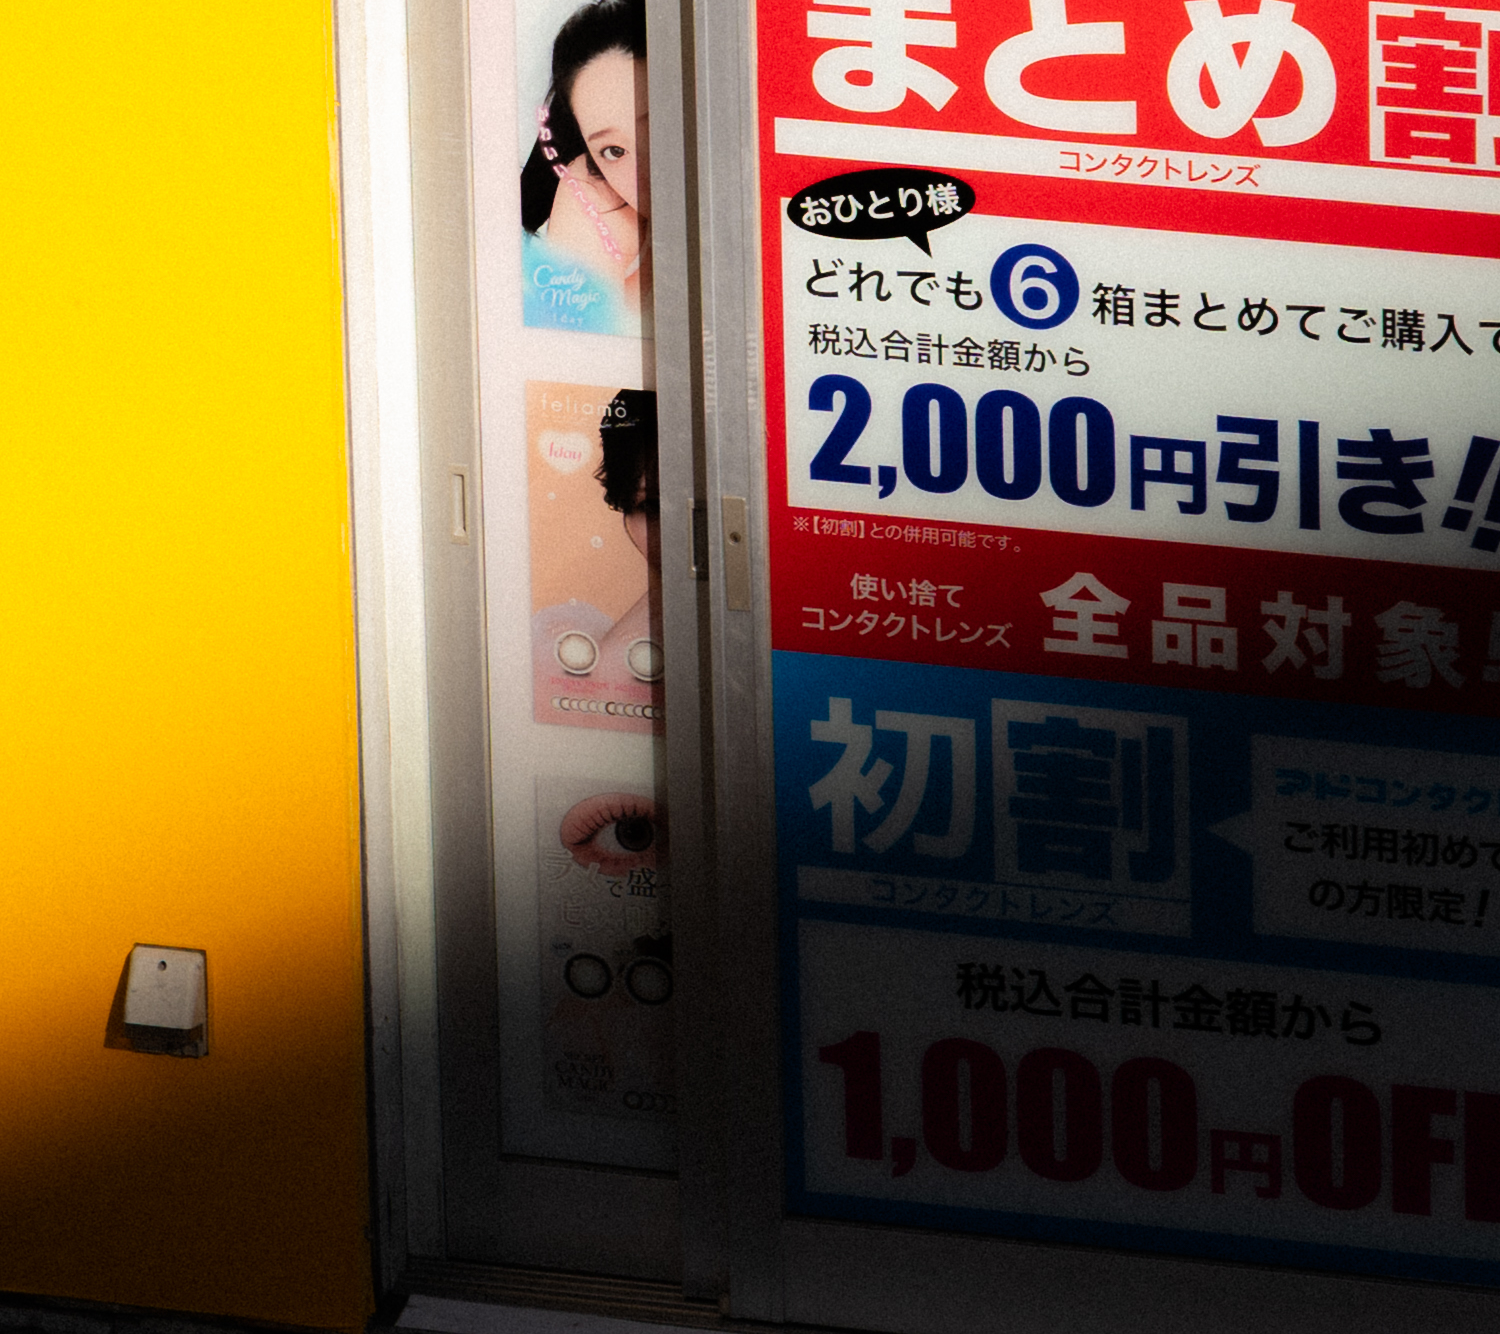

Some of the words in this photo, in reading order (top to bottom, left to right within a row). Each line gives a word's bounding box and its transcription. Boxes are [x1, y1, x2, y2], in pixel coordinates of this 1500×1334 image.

[1058, 151, 1261, 189] コンタクトレンズ
[799, 182, 965, 229] おひとり様
[808, 322, 1092, 378] 税込合計金額から
[850, 573, 965, 610] 使い捨て
[801, 606, 1011, 650] コンタクトレンズ
[809, 696, 1190, 885] 初割
[872, 878, 1116, 926] コンタクトレンズ
[1308, 878, 1491, 929] の方限定!
[956, 962, 1381, 1046] 税込合計金額から
